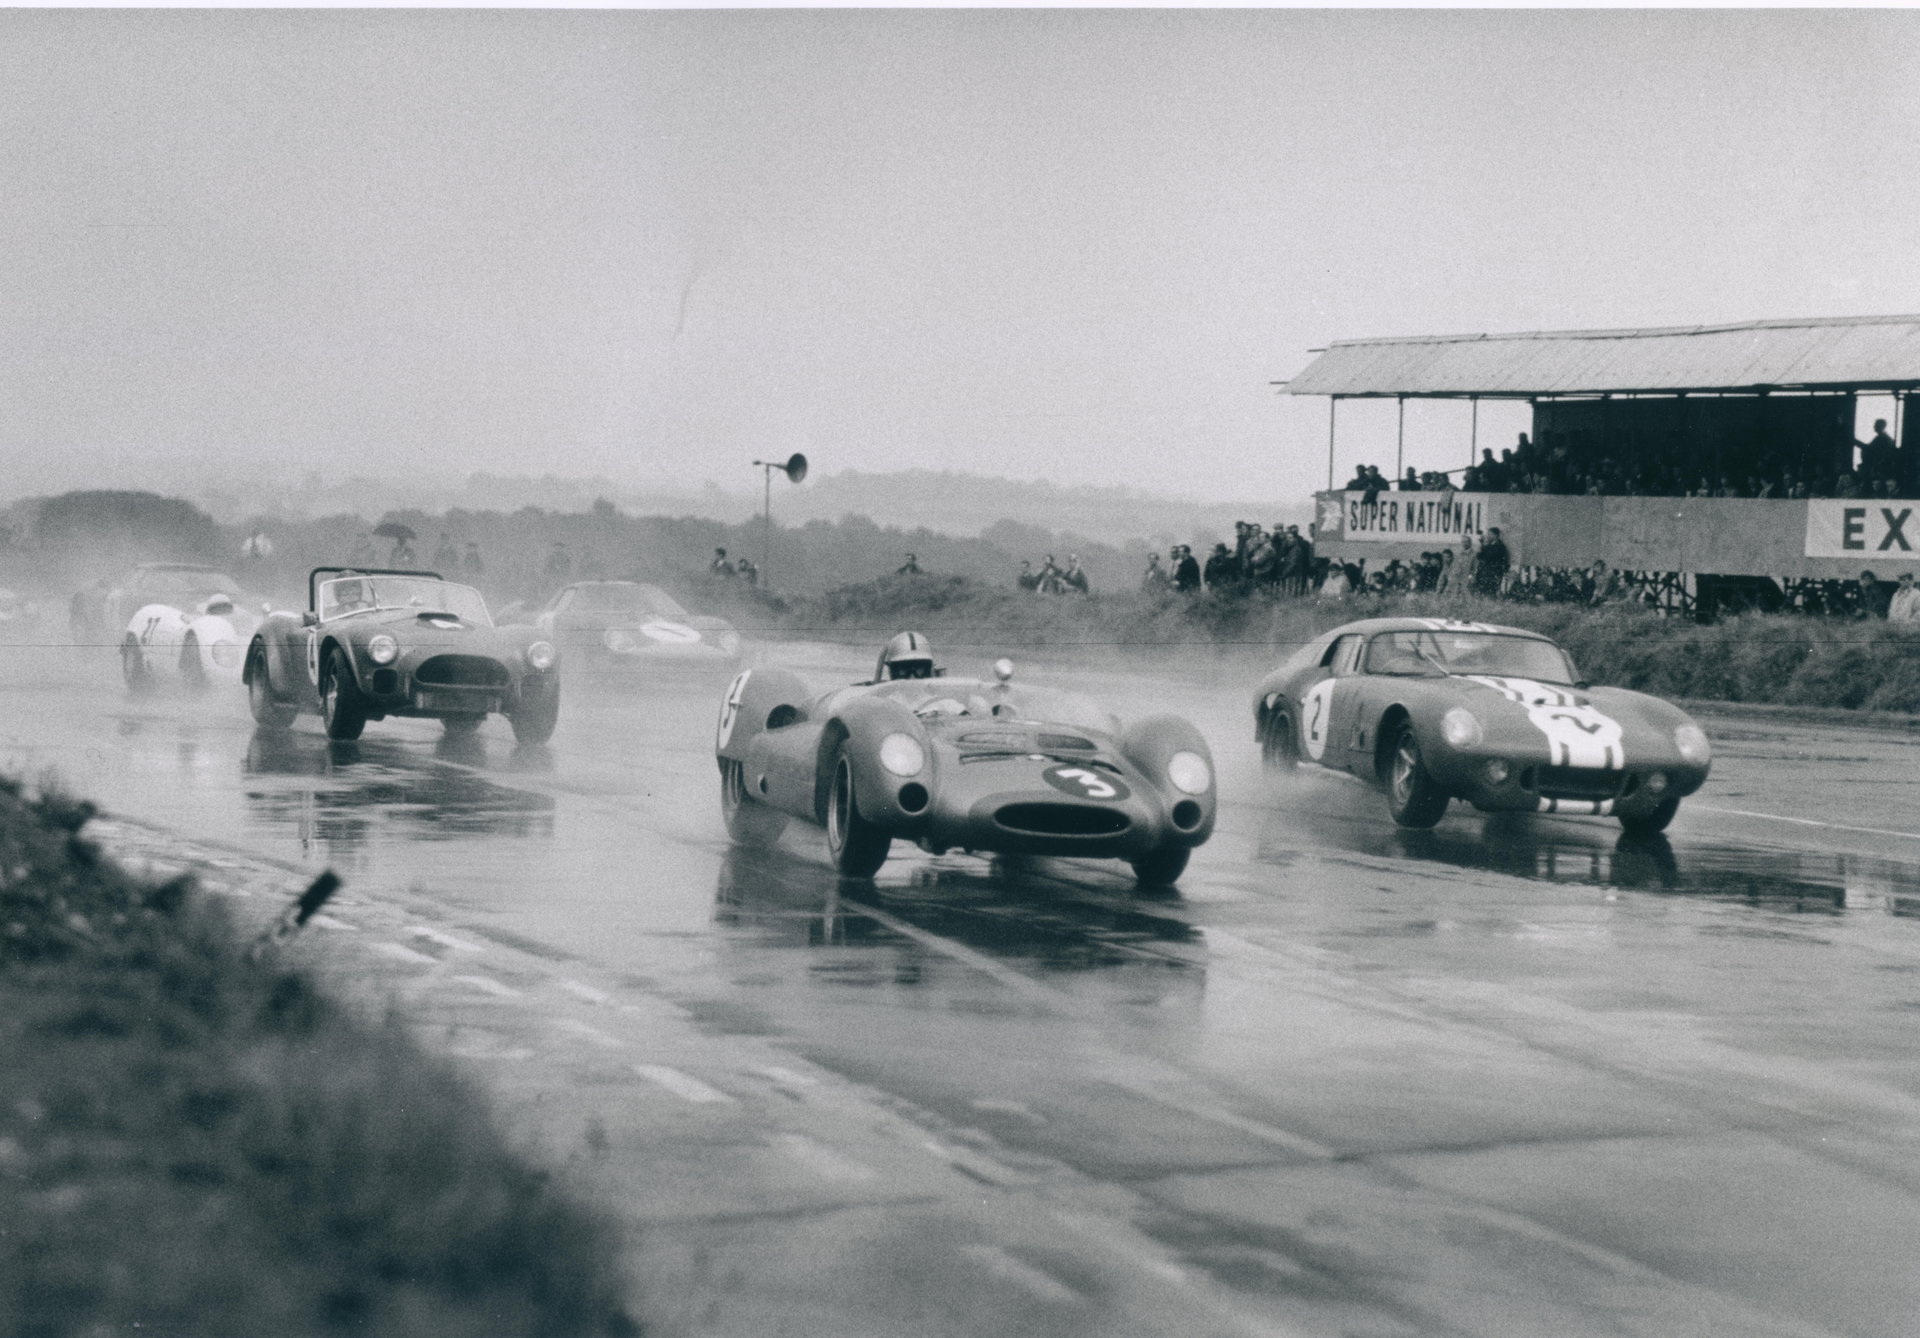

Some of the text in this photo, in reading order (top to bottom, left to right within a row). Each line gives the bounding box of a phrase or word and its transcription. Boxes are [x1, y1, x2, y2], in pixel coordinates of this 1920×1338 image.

[1350, 500, 1483, 535] SUPER NATIONAL
[1842, 507, 1913, 551] EX
[1310, 694, 1321, 741] 2
[1551, 713, 1603, 735] 2
[1056, 768, 1117, 798] 3
